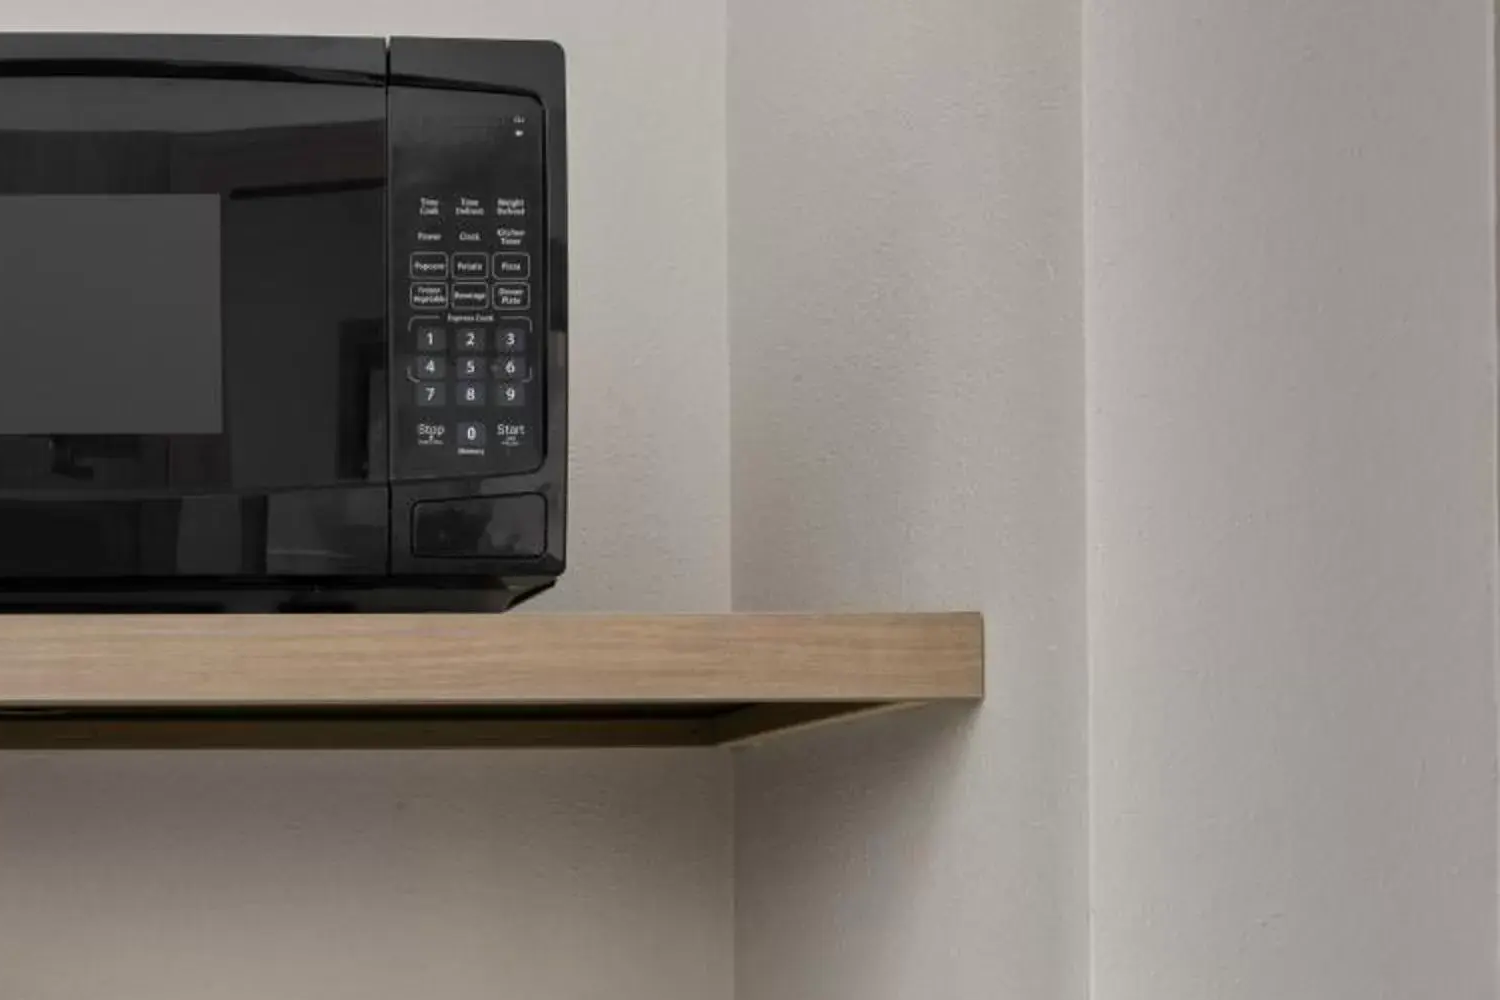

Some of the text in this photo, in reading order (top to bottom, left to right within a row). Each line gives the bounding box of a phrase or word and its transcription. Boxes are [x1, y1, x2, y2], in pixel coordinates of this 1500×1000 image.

[459, 231, 481, 241] Clock
[414, 261, 445, 271] Popcorn
[426, 332, 433, 345] 1
[465, 332, 475, 346] 2
[505, 332, 515, 345] 3
[425, 360, 435, 373] 4
[466, 360, 475, 374] 5
[505, 360, 516, 374] 6
[425, 387, 436, 401] 7
[466, 387, 475, 401] 8
[505, 387, 516, 401] 9
[418, 423, 445, 437] Stop
[467, 426, 477, 441] 0
[497, 423, 525, 436] Start
